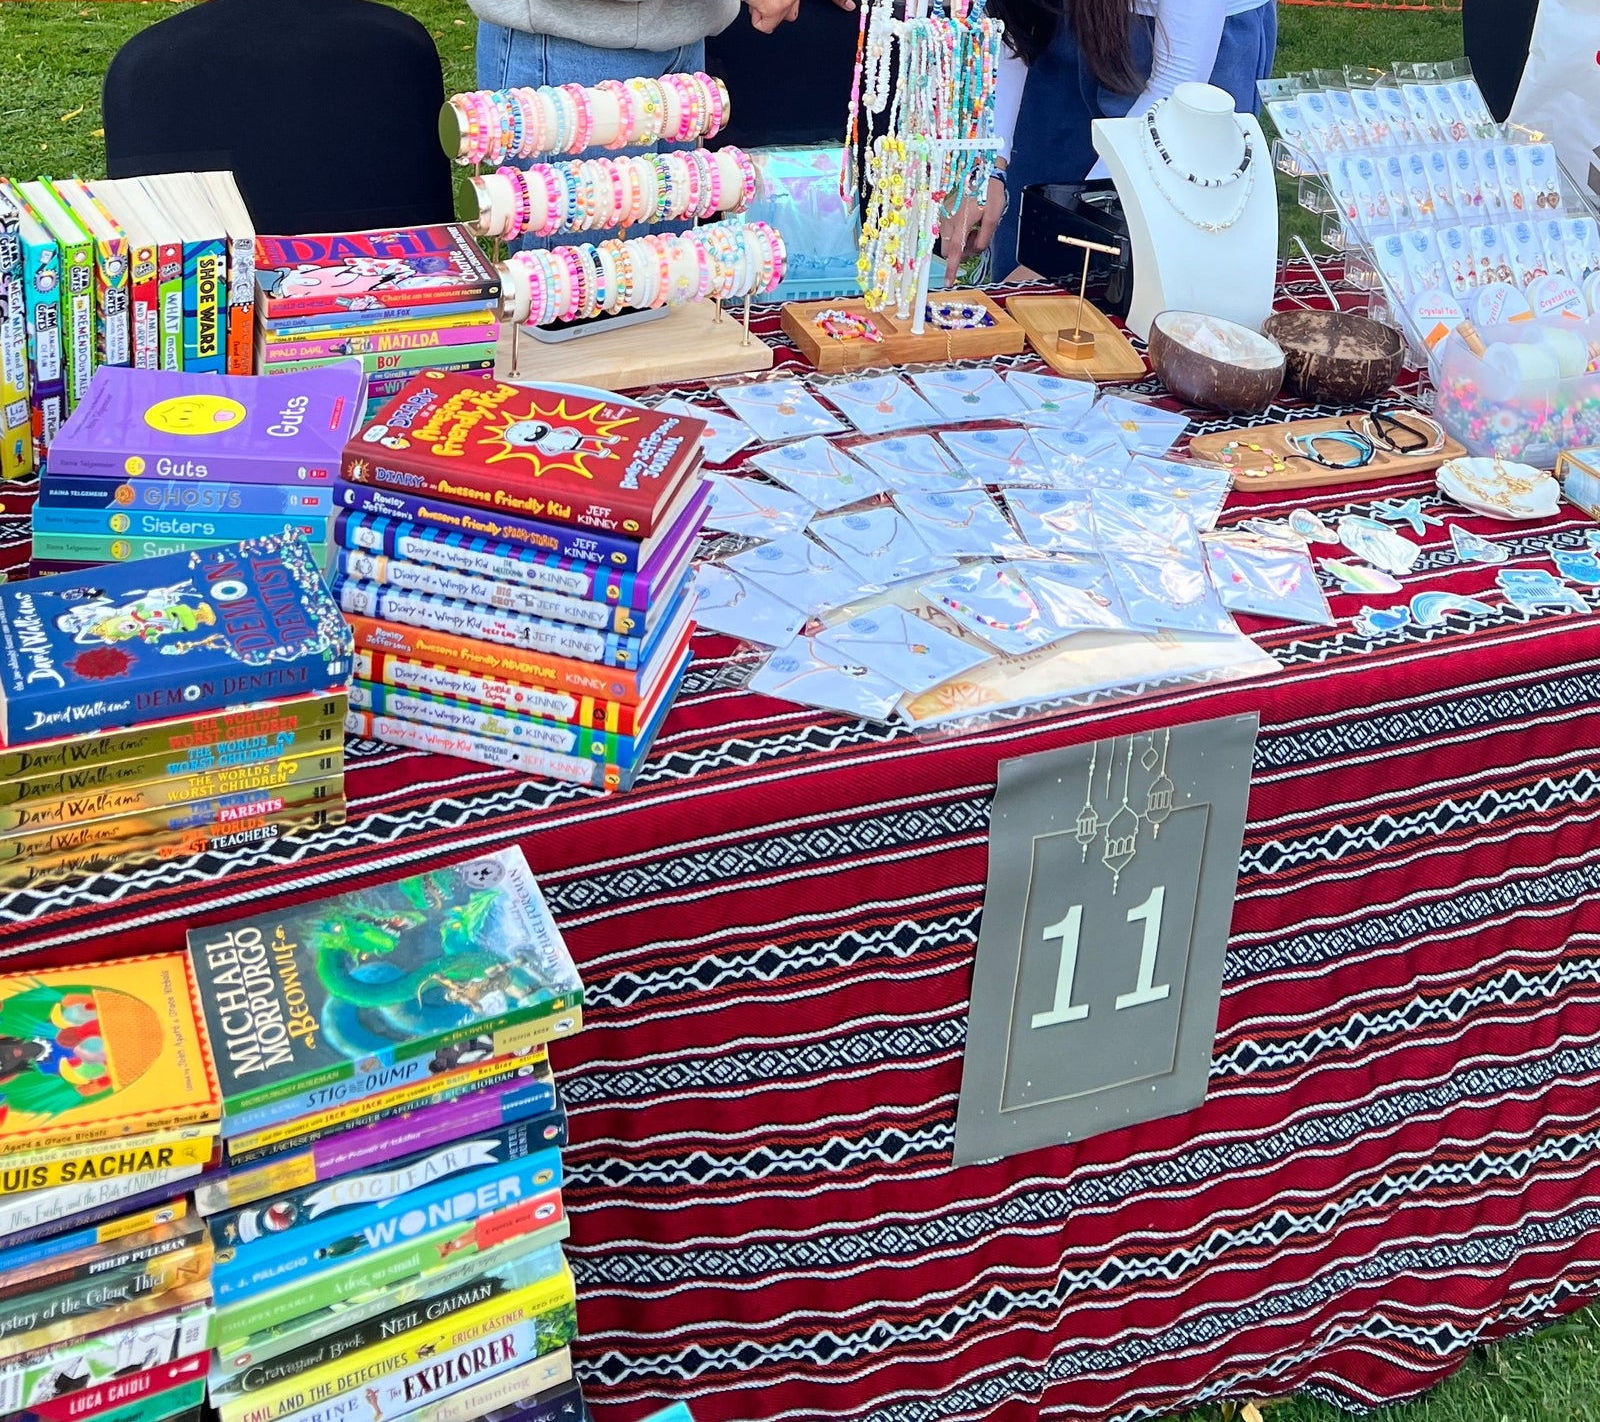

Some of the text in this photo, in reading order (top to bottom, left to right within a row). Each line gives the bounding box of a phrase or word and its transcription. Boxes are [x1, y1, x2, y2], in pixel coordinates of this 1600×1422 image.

[277, 229, 452, 264] DAHL
[449, 251, 480, 281] Charlie
[107, 289, 118, 316] GATES
[167, 293, 178, 332] WHAT
[200, 259, 215, 355] SHOE WARS
[1419, 308, 1444, 316] Crystal
[1539, 288, 1577, 308] Crystal Tec
[10, 281, 23, 347] MEGA MAKE
[38, 304, 47, 332] GATES
[269, 347, 298, 359] ROALD
[300, 345, 324, 355] DAHL
[378, 333, 440, 352] MATILDA
[377, 355, 402, 370] BOY
[79, 374, 88, 396] TALES
[267, 396, 309, 437] Guts
[387, 388, 439, 428] DIARY
[412, 388, 480, 441] Awesome
[431, 406, 497, 457] Friendly
[469, 383, 520, 409] Kid
[156, 458, 208, 478] Guts
[642, 436, 684, 479] JOURNAL
[49, 487, 242, 508] RAINA TELGEMEIER GHOSTS
[373, 492, 406, 509] Rowley
[375, 466, 572, 520] DIARY Awesome Friendly Kid
[362, 499, 414, 521] Jefferson's
[577, 514, 619, 531] KINNEY
[586, 504, 612, 518] JEFF
[142, 516, 215, 535] Sisters
[417, 506, 559, 551] Awesome Friendly STORIES
[406, 542, 490, 570] Diary Wimpy Kid
[563, 546, 606, 563] KINNEY
[572, 538, 599, 551] JEFF
[393, 566, 487, 597] Diary Wimpy Kid
[495, 585, 512, 597] BIG
[539, 572, 581, 588] KINNEY
[203, 561, 274, 653] DEMON
[251, 556, 316, 644] DENTIST
[388, 599, 483, 631] Diary Wimpy Kid
[491, 595, 516, 607] SHOT
[536, 599, 606, 622] JEFF KINNEY
[14, 591, 65, 688] David Walliams
[375, 627, 405, 642] Rowley
[532, 631, 602, 654] JEFF KINNEY
[394, 666, 477, 694] Diary Wimpy Kid
[415, 639, 608, 691] Awesome Friendly ADVENTURE KINNEY
[25, 666, 309, 730] David Walliams DEMON DENTIST
[395, 699, 476, 727] Diary Wimpy Kid
[526, 694, 568, 711] KINNEY
[168, 716, 298, 749] WORST CHILDREN
[192, 718, 217, 730] THE
[380, 722, 473, 754] Diary Wimpy Kid
[525, 728, 568, 744] KINNEY
[6, 737, 149, 776] David Walliams
[166, 743, 285, 775] WORST CHILDREN
[187, 731, 295, 759] THE 2
[483, 751, 501, 762] BALL
[188, 761, 298, 787] THE 3
[522, 755, 589, 777] JEFF KINNEY
[3, 764, 145, 805] David Walliams
[167, 773, 287, 801] WORST CHILDREN
[4, 792, 145, 831] David Walliams
[220, 799, 282, 822] PARENTS
[12, 827, 120, 857] David Walliams
[211, 824, 279, 850] TEACHERS
[1031, 886, 1170, 1030] 11
[205, 931, 262, 1079] MICHAEL
[235, 925, 295, 1072] MORPURGO
[306, 1085, 348, 1108] STIG
[366, 1062, 419, 1089] DUMP
[391, 1070, 515, 1116] APOLLO RIORDAN
[362, 1099, 384, 1112] JACK
[3, 1114, 198, 1154] Agard Grace Walker Books
[30, 1136, 156, 1165] DARK AND STORMY NIGHT
[60, 1146, 174, 1185] SACHAR
[252, 1176, 522, 1283] PALACIO WONDER
[88, 1238, 187, 1275] PHILIP PULLMAN
[388, 1252, 421, 1275] small
[0, 1272, 167, 1340] ystery of the Colour Thief
[241, 1347, 325, 1393] Graveyard
[329, 1333, 366, 1360] Book
[379, 1311, 423, 1340] NEIL
[426, 1283, 494, 1321] GAIMAN
[243, 1308, 524, 1422] EMIL AND THE DETECTIVES ERICH KÄSTNER
[402, 1333, 518, 1404] EXPLORER
[69, 1391, 103, 1416] LUCA
[108, 1375, 151, 1402] CAIOLI
[464, 1377, 531, 1411] Haunting
